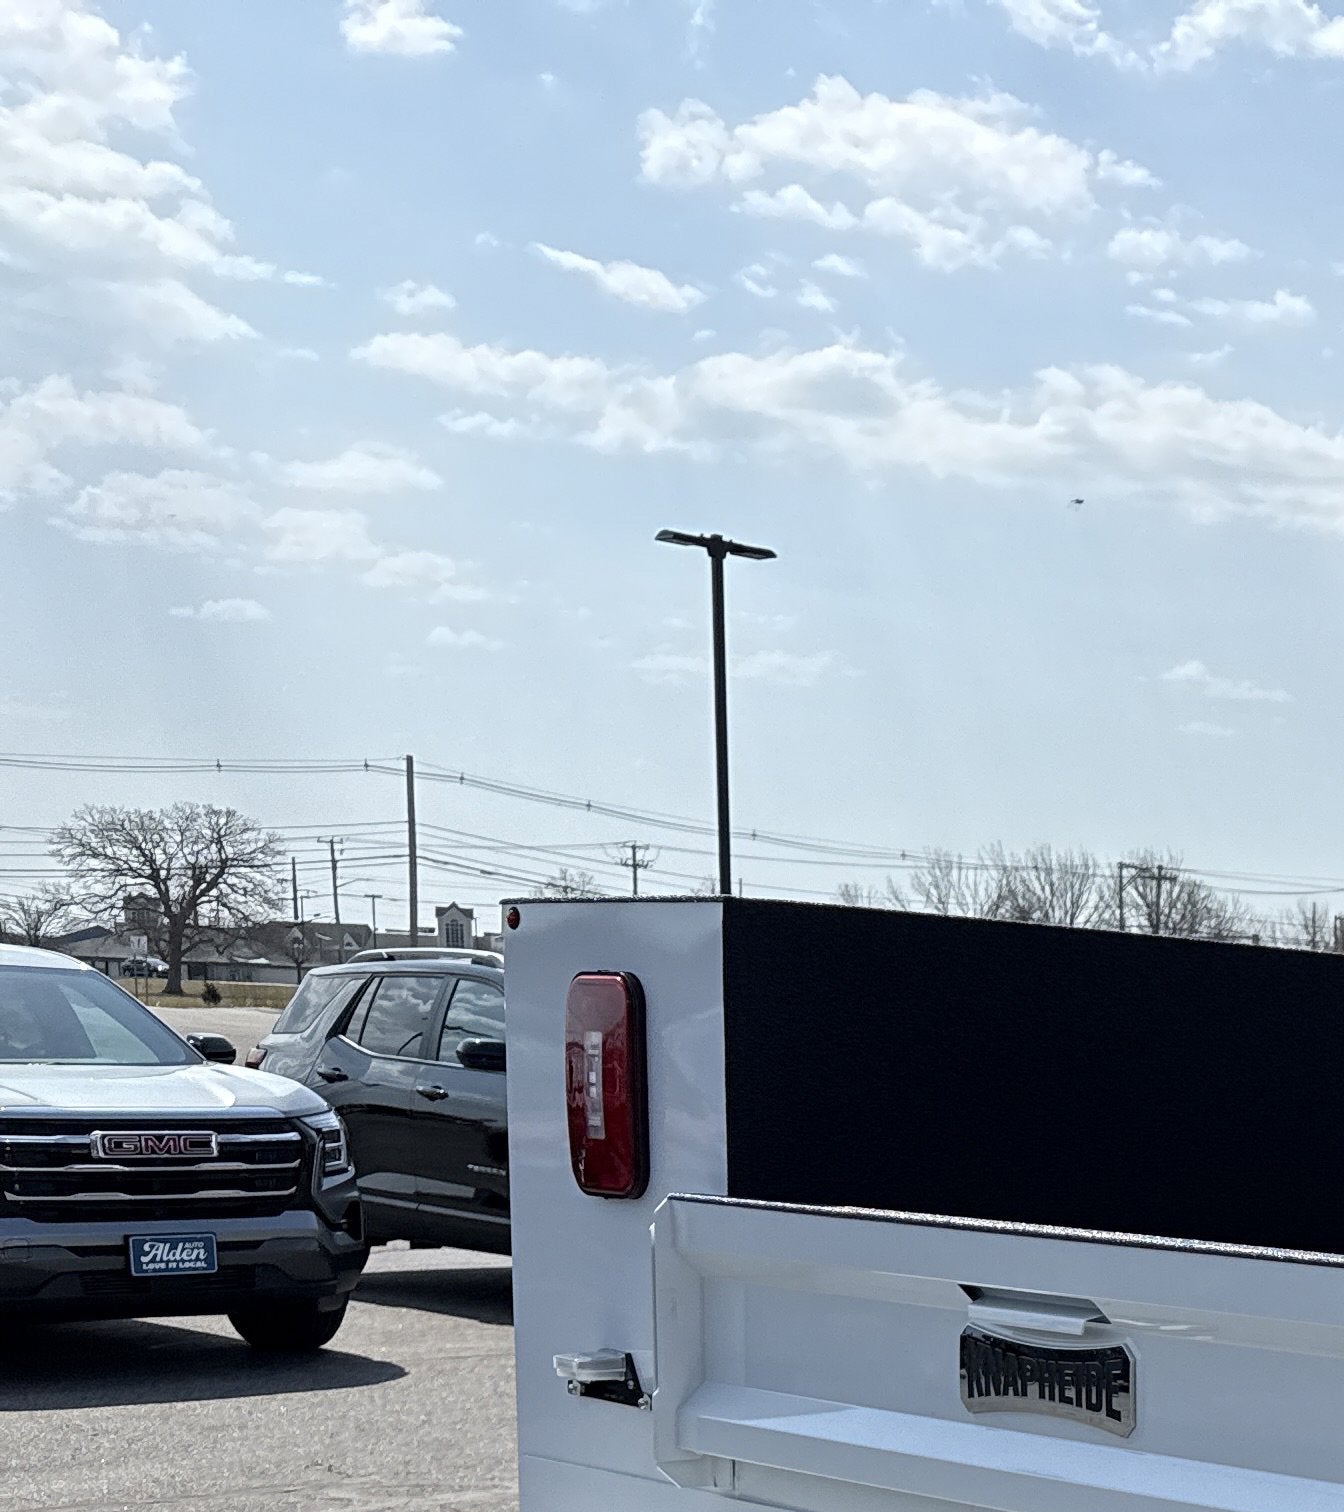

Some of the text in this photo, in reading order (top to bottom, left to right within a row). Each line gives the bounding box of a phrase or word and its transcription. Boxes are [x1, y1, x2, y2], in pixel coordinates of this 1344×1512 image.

[104, 1136, 212, 1154] GMC
[140, 1242, 208, 1263] Alden
[967, 1338, 1122, 1422] KNAPHEIDE
